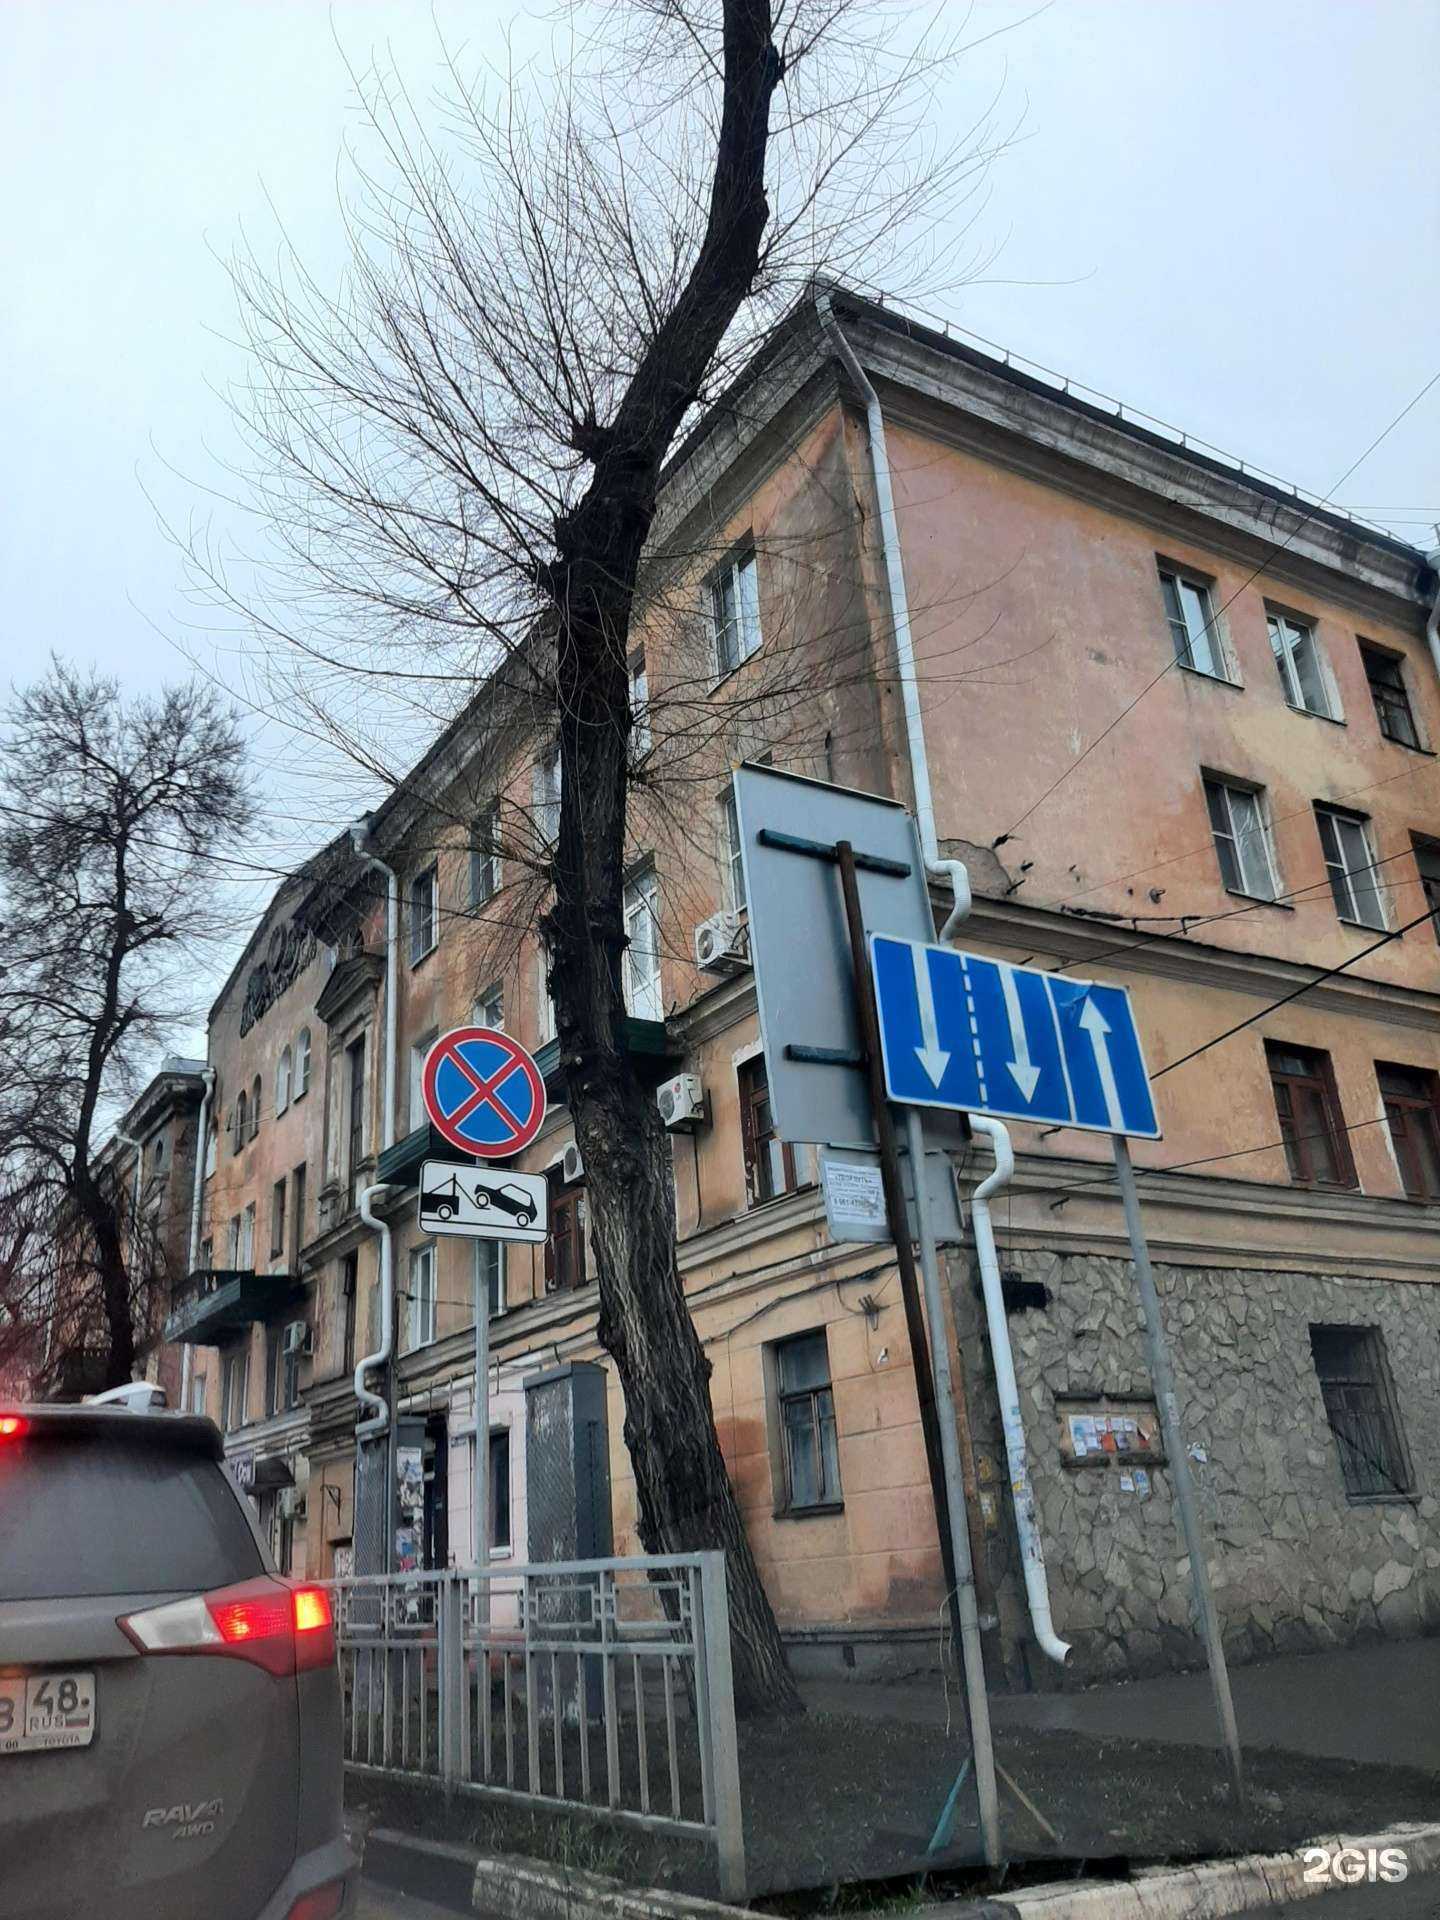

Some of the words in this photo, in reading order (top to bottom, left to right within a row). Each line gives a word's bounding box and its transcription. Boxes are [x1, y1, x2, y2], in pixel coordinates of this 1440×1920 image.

[33, 1679, 78, 1715] 48
[30, 1714, 65, 1731] RUS
[43, 1735, 80, 1746] TOYOTA
